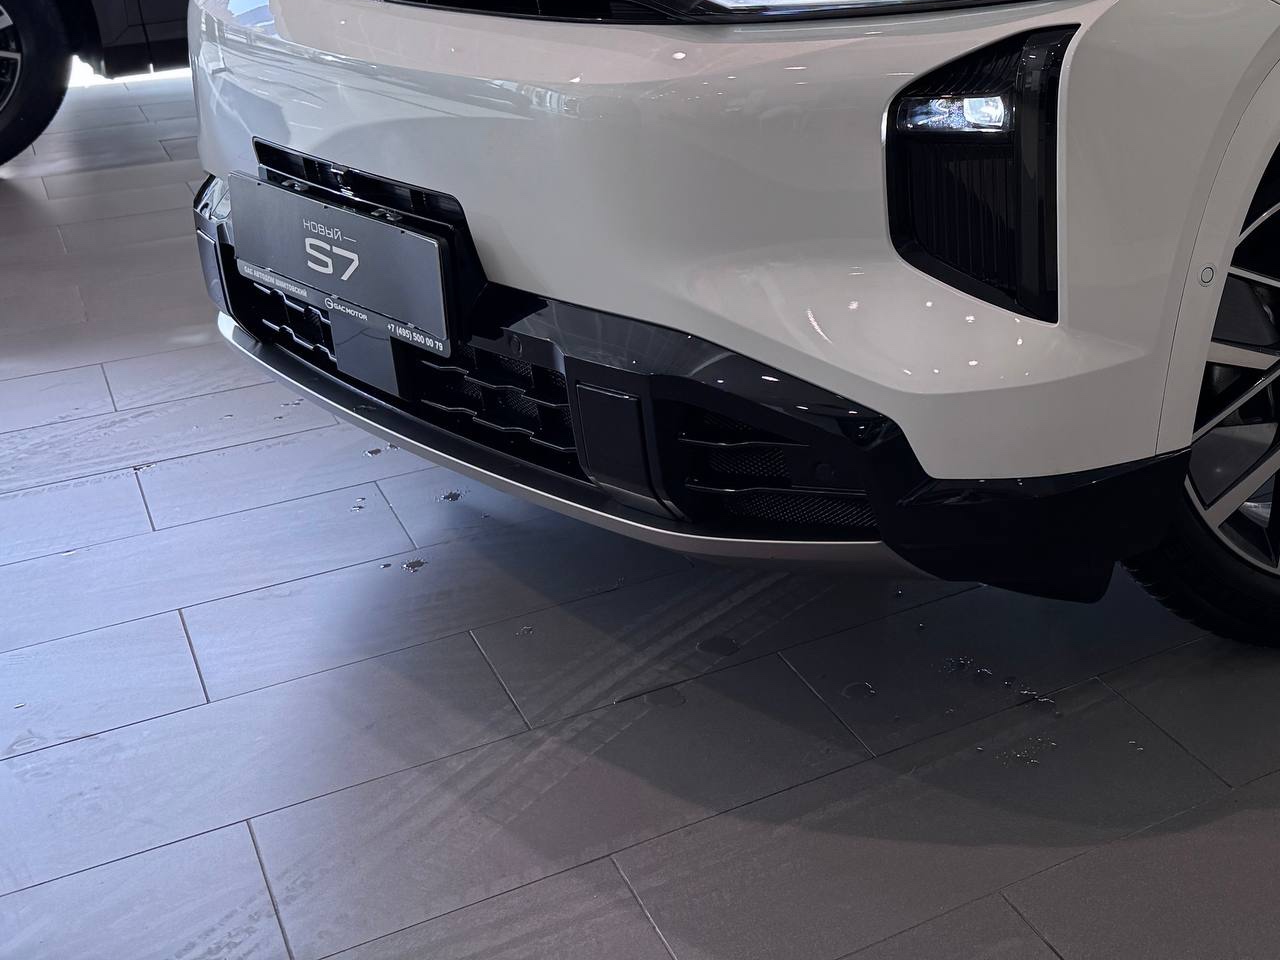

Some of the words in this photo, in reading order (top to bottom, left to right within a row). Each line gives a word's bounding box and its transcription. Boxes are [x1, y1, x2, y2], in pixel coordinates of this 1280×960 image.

[302, 218, 342, 241] НОВЫЙ
[305, 237, 359, 280] S7
[387, 323, 395, 332] +7
[396, 325, 412, 341] (495)
[412, 332, 425, 344] 500
[434, 341, 443, 351] 79
